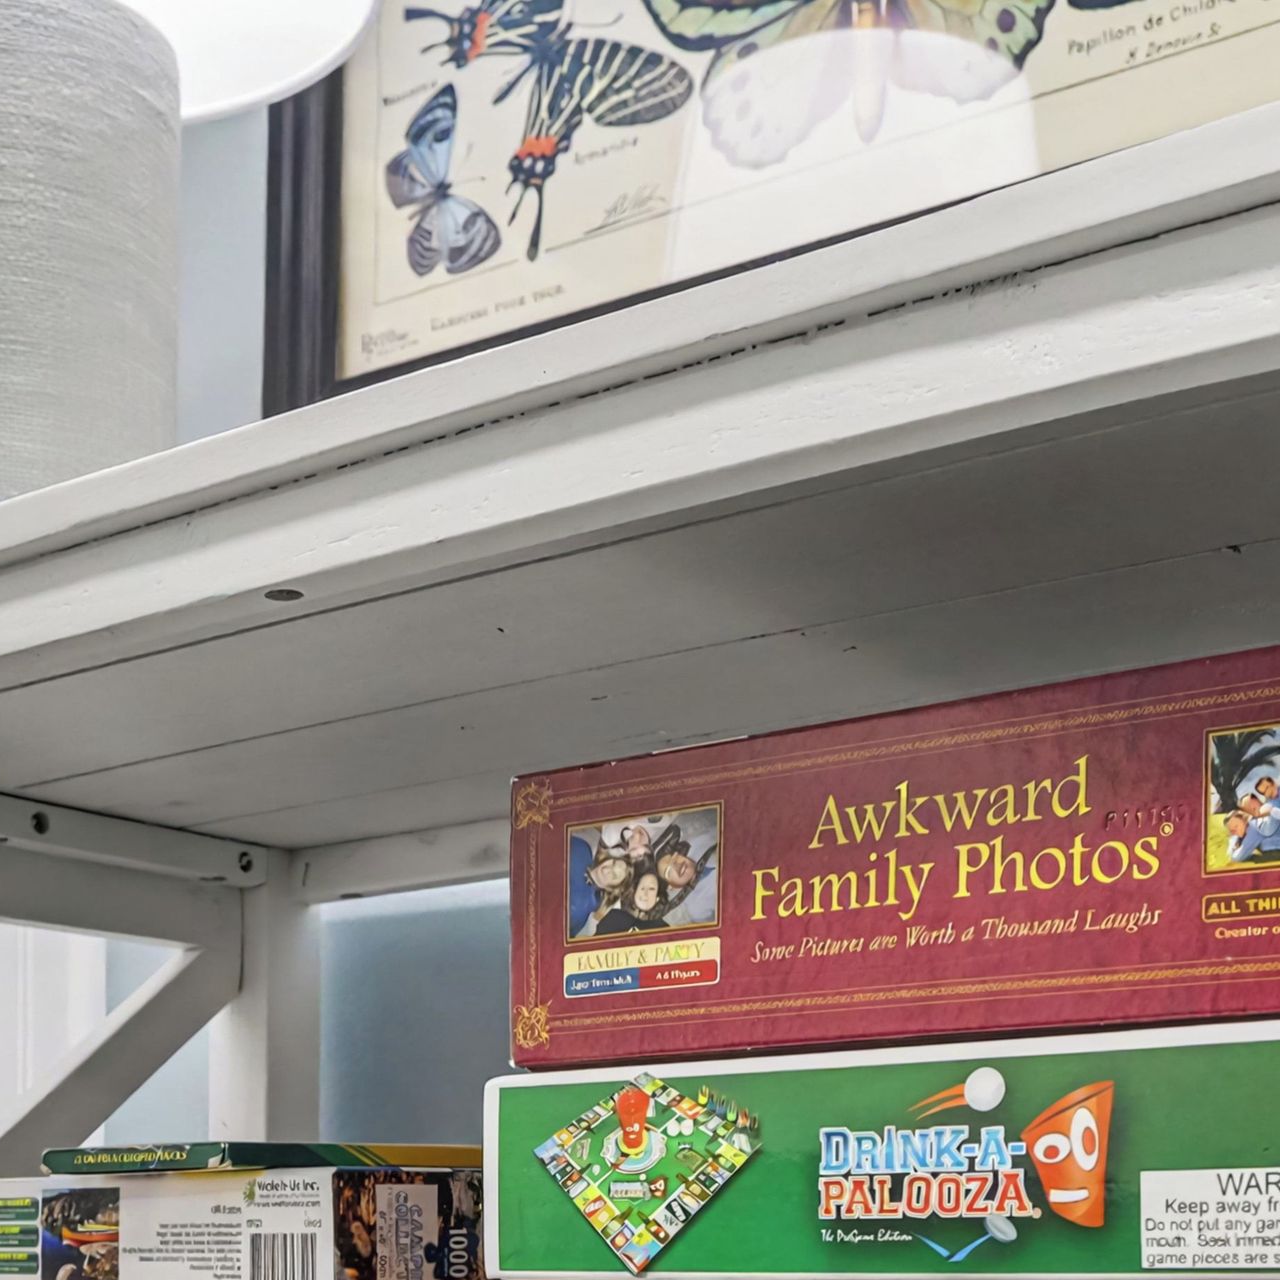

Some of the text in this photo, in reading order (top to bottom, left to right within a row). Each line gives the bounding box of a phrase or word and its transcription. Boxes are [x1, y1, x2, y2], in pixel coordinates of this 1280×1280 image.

[808, 753, 1092, 850] Awkward
[750, 847, 935, 921] Family
[1206, 901, 1240, 916] ALL
[797, 934, 865, 959] Pictures
[869, 935, 897, 951] are
[905, 922, 956, 950] Worth
[961, 926, 975, 942] a
[980, 910, 1077, 942] Thousand
[1084, 903, 1163, 933] Laughs
[636, 947, 648, 965] &
[818, 1124, 1027, 1176] DRINK-A-
[1164, 1197, 1210, 1217] Keep
[1215, 1200, 1261, 1216] away
[1144, 1217, 1166, 1232] Do
[1169, 1218, 1194, 1232] not
[1197, 1217, 1220, 1234] put
[1224, 1219, 1251, 1234] any
[448, 1226, 469, 1279] 1000
[1146, 1253, 1188, 1268] game
[1192, 1251, 1239, 1267] pieces
[1244, 1251, 1269, 1265] are
